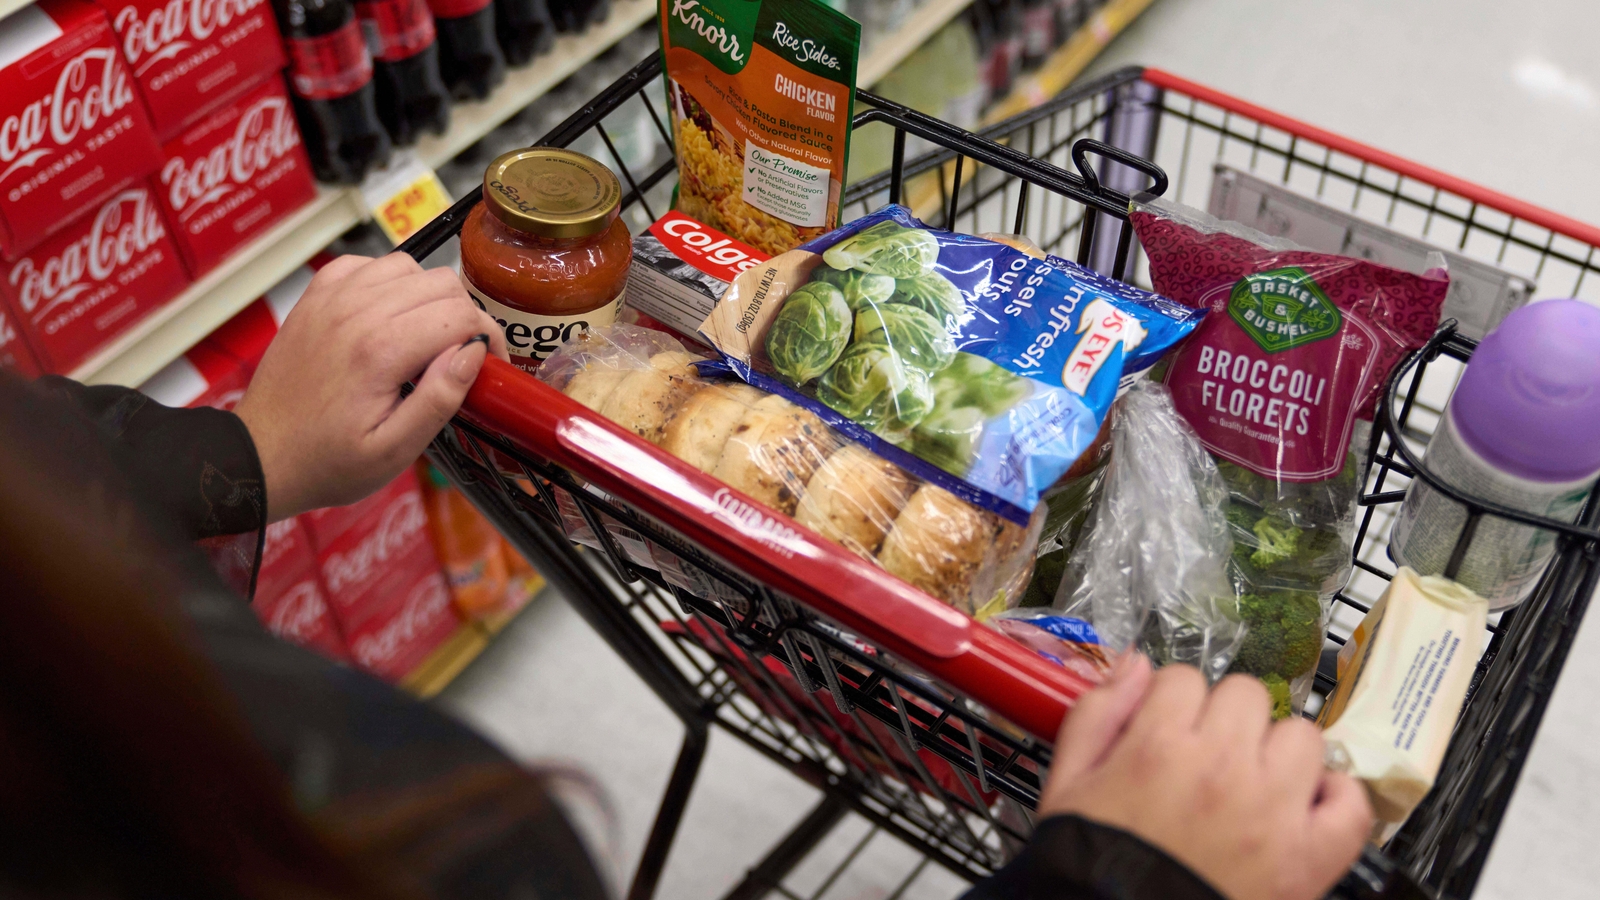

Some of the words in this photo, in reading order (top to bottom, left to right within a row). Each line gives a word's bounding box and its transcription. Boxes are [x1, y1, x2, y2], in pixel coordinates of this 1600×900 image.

[671, 0, 744, 62] Knorr
[772, 22, 799, 50] Rice
[795, 39, 839, 69] Sides
[774, 73, 836, 113] CHICKEN
[704, 75, 725, 100] Savory
[726, 95, 751, 121] Chicken
[752, 117, 797, 141] Flavored
[800, 134, 833, 153] Sauce
[728, 85, 742, 105] Rice
[743, 99, 749, 110] &
[751, 103, 776, 125] Pasta
[779, 118, 811, 135] Blend
[814, 128, 823, 138] in
[806, 106, 835, 123] FLAVOR
[735, 117, 748, 133] With
[749, 129, 769, 145] Other
[771, 140, 803, 157] Natural
[805, 151, 832, 165] Flavor
[8, 150, 86, 202] ORIGINAL
[86, 115, 134, 151] TASTE
[751, 149, 770, 164] Our
[773, 158, 818, 181] Promise
[490, 180, 538, 213] Prego
[757, 186, 766, 195] No
[767, 191, 788, 204] Added
[789, 200, 807, 210] MSG
[758, 169, 767, 178] No
[768, 174, 796, 189] Artificial
[797, 185, 823, 195] Flavors
[765, 179, 809, 200] Preservatives
[759, 279, 771, 293] WT
[764, 267, 778, 281] NET
[748, 303, 760, 314] OZ
[753, 291, 766, 305] 10.8
[1250, 281, 1320, 309] BASKET
[1275, 303, 1287, 316] &
[468, 290, 589, 361] rego
[735, 311, 756, 334] (306g)
[1013, 283, 1084, 367] mfresh
[1243, 309, 1307, 336] BUSHEL
[1072, 334, 1110, 378] EYE
[1197, 345, 1327, 406] BROCCOLI
[1201, 380, 1309, 435] FLORETS
[1219, 417, 1243, 434] Quality
